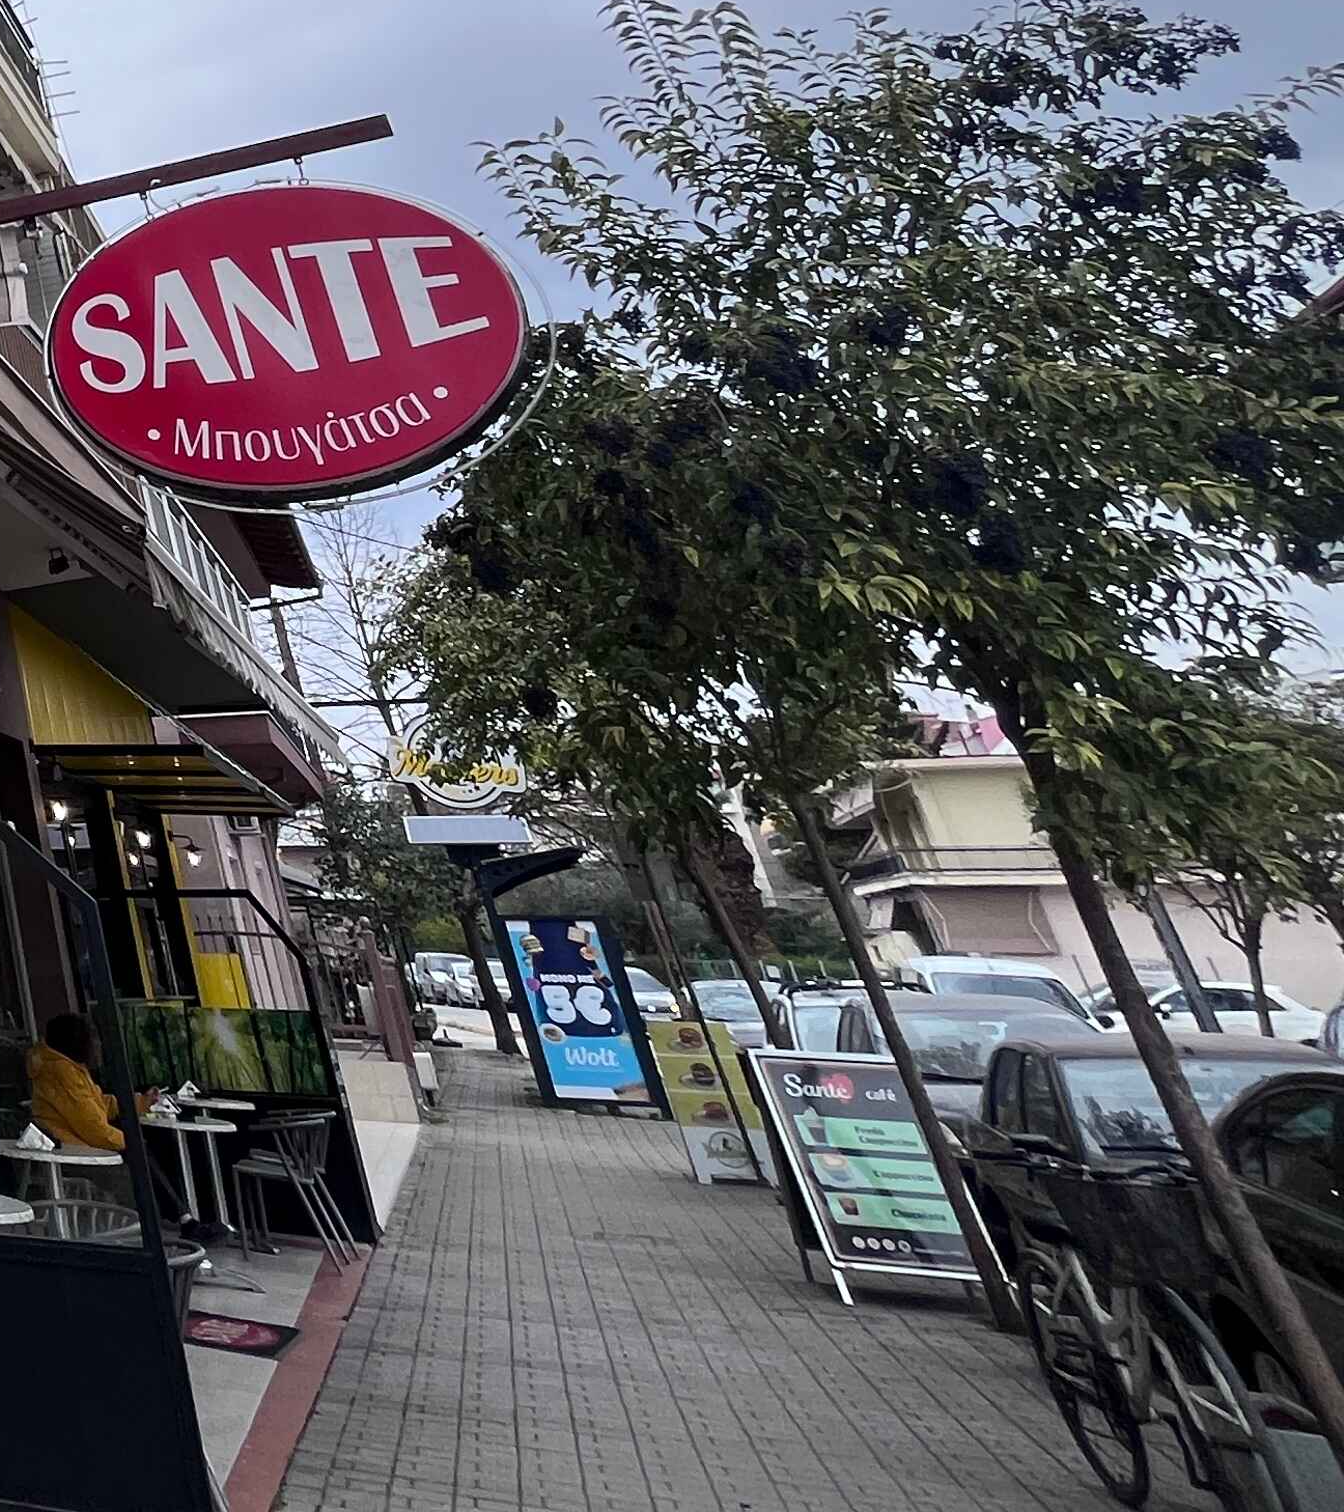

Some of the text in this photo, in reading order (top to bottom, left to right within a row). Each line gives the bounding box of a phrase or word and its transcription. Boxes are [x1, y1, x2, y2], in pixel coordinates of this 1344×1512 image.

[71, 235, 490, 394] SANTE
[173, 390, 431, 466] Μπουγάτσα
[564, 1047, 620, 1067] Wolt
